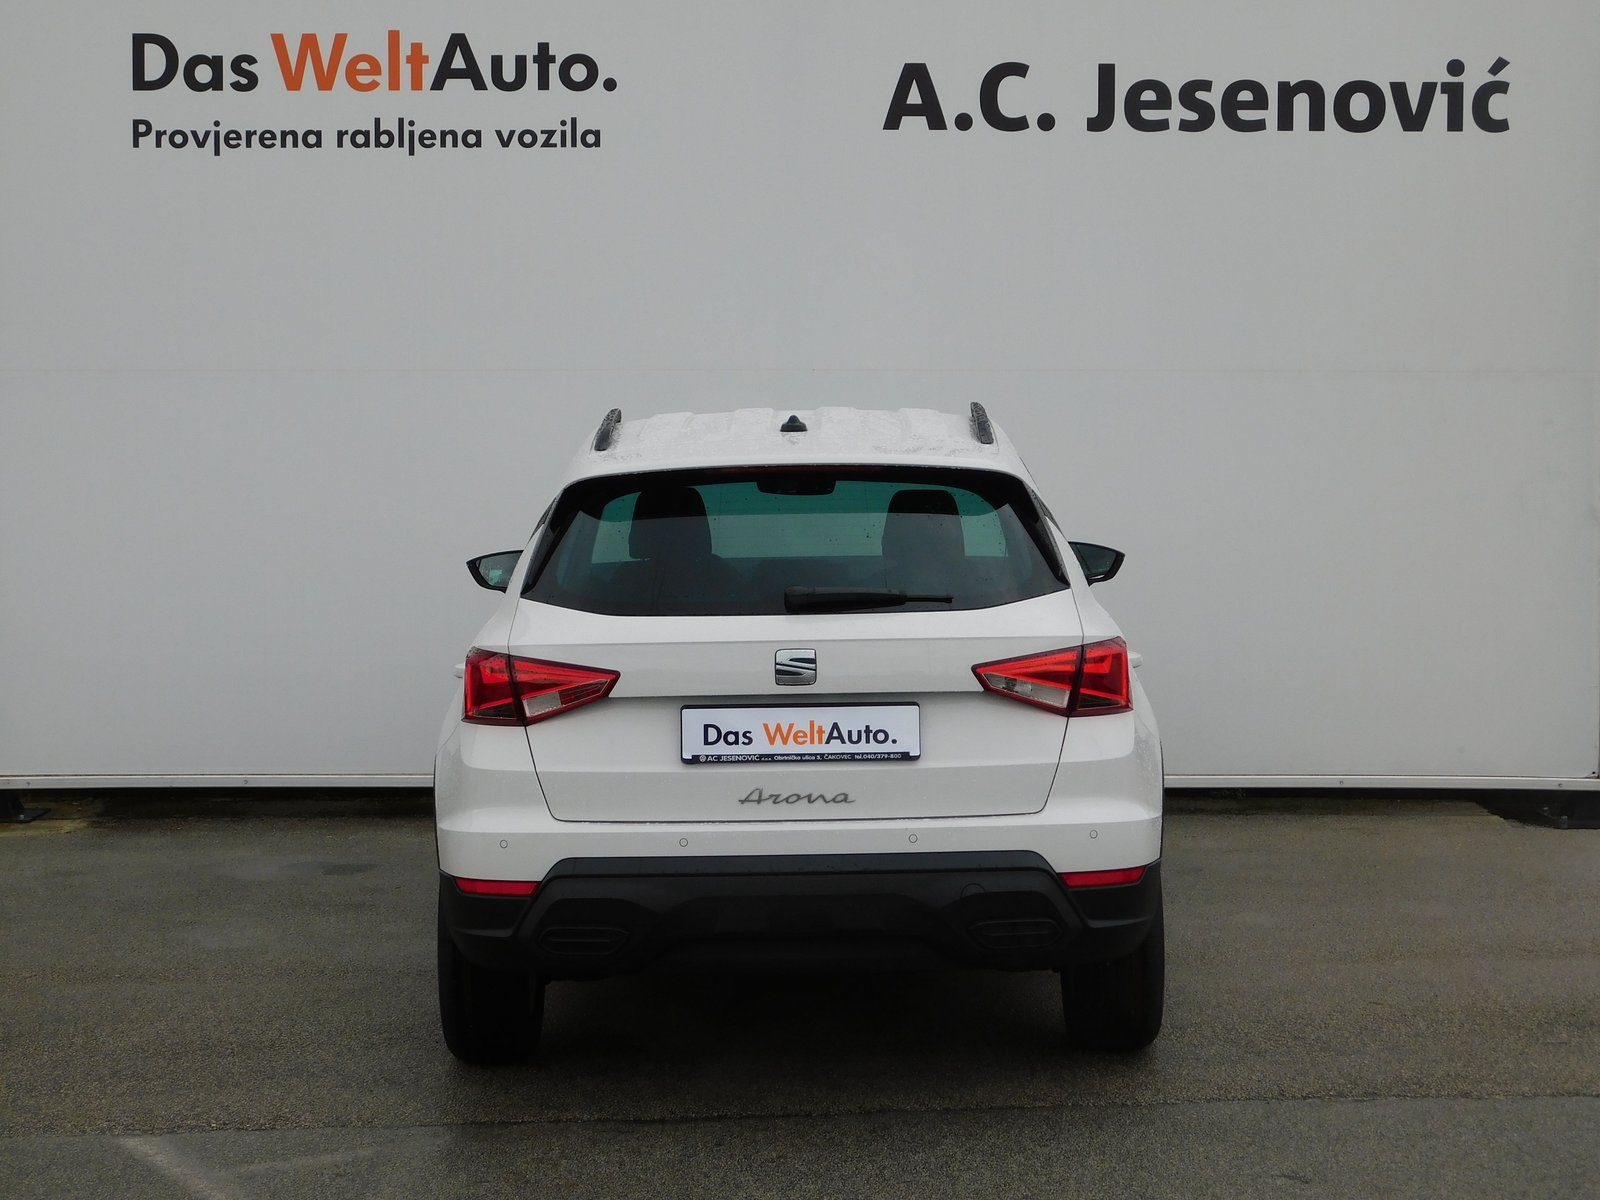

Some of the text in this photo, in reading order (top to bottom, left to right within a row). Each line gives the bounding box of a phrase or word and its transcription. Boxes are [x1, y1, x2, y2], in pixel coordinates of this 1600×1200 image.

[132, 30, 618, 92] Das WeltAuto.
[882, 57, 1511, 134] A.C. Jesenović
[132, 117, 601, 157] Provjerena rabljena vozila
[703, 720, 898, 746] Das WeltAuto.
[738, 787, 856, 805] Arona
